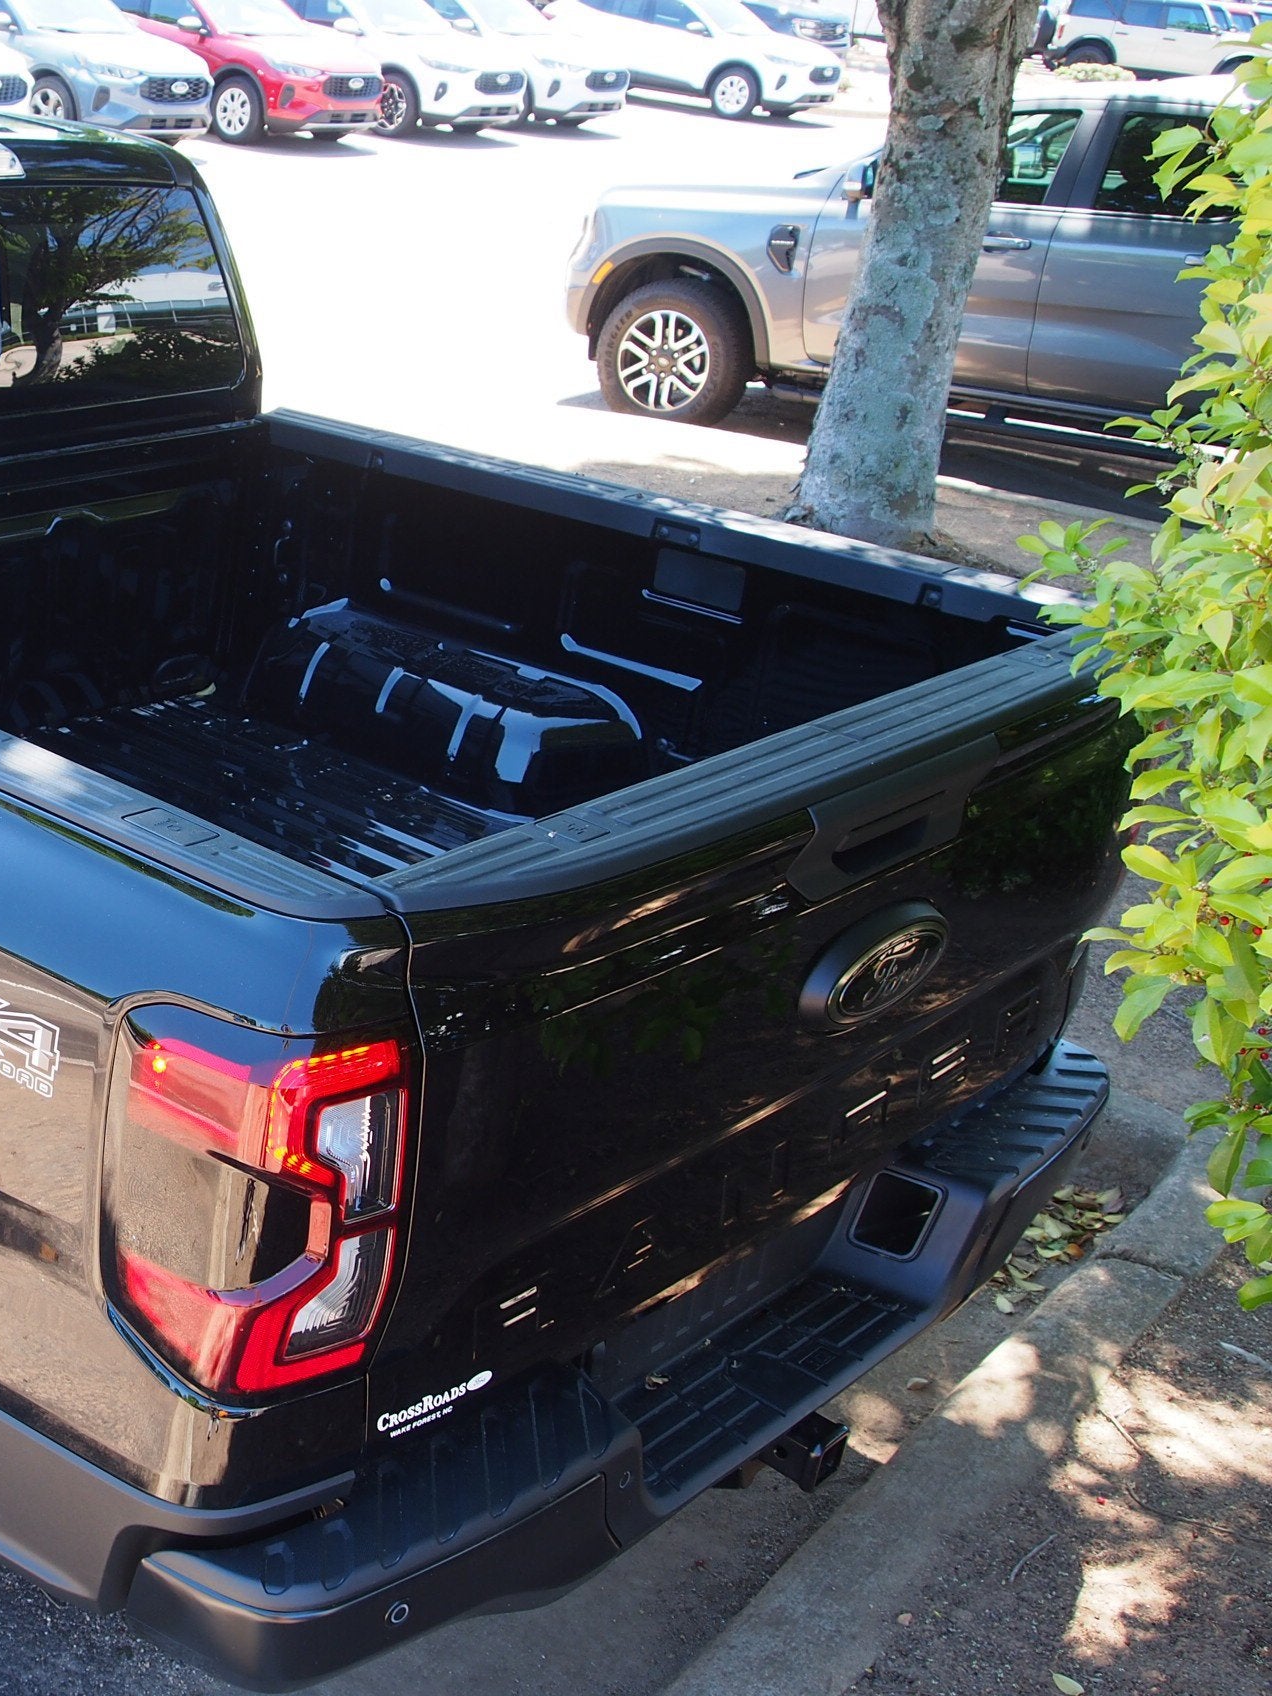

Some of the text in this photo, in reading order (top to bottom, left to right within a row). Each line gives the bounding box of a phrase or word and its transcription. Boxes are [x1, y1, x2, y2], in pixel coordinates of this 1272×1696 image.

[605, 310, 633, 381] RANGLER
[471, 984, 1042, 1362] RANGER
[377, 1382, 467, 1432] CROSSROADS
[389, 1405, 454, 1438] WAKE FOREST, NC
